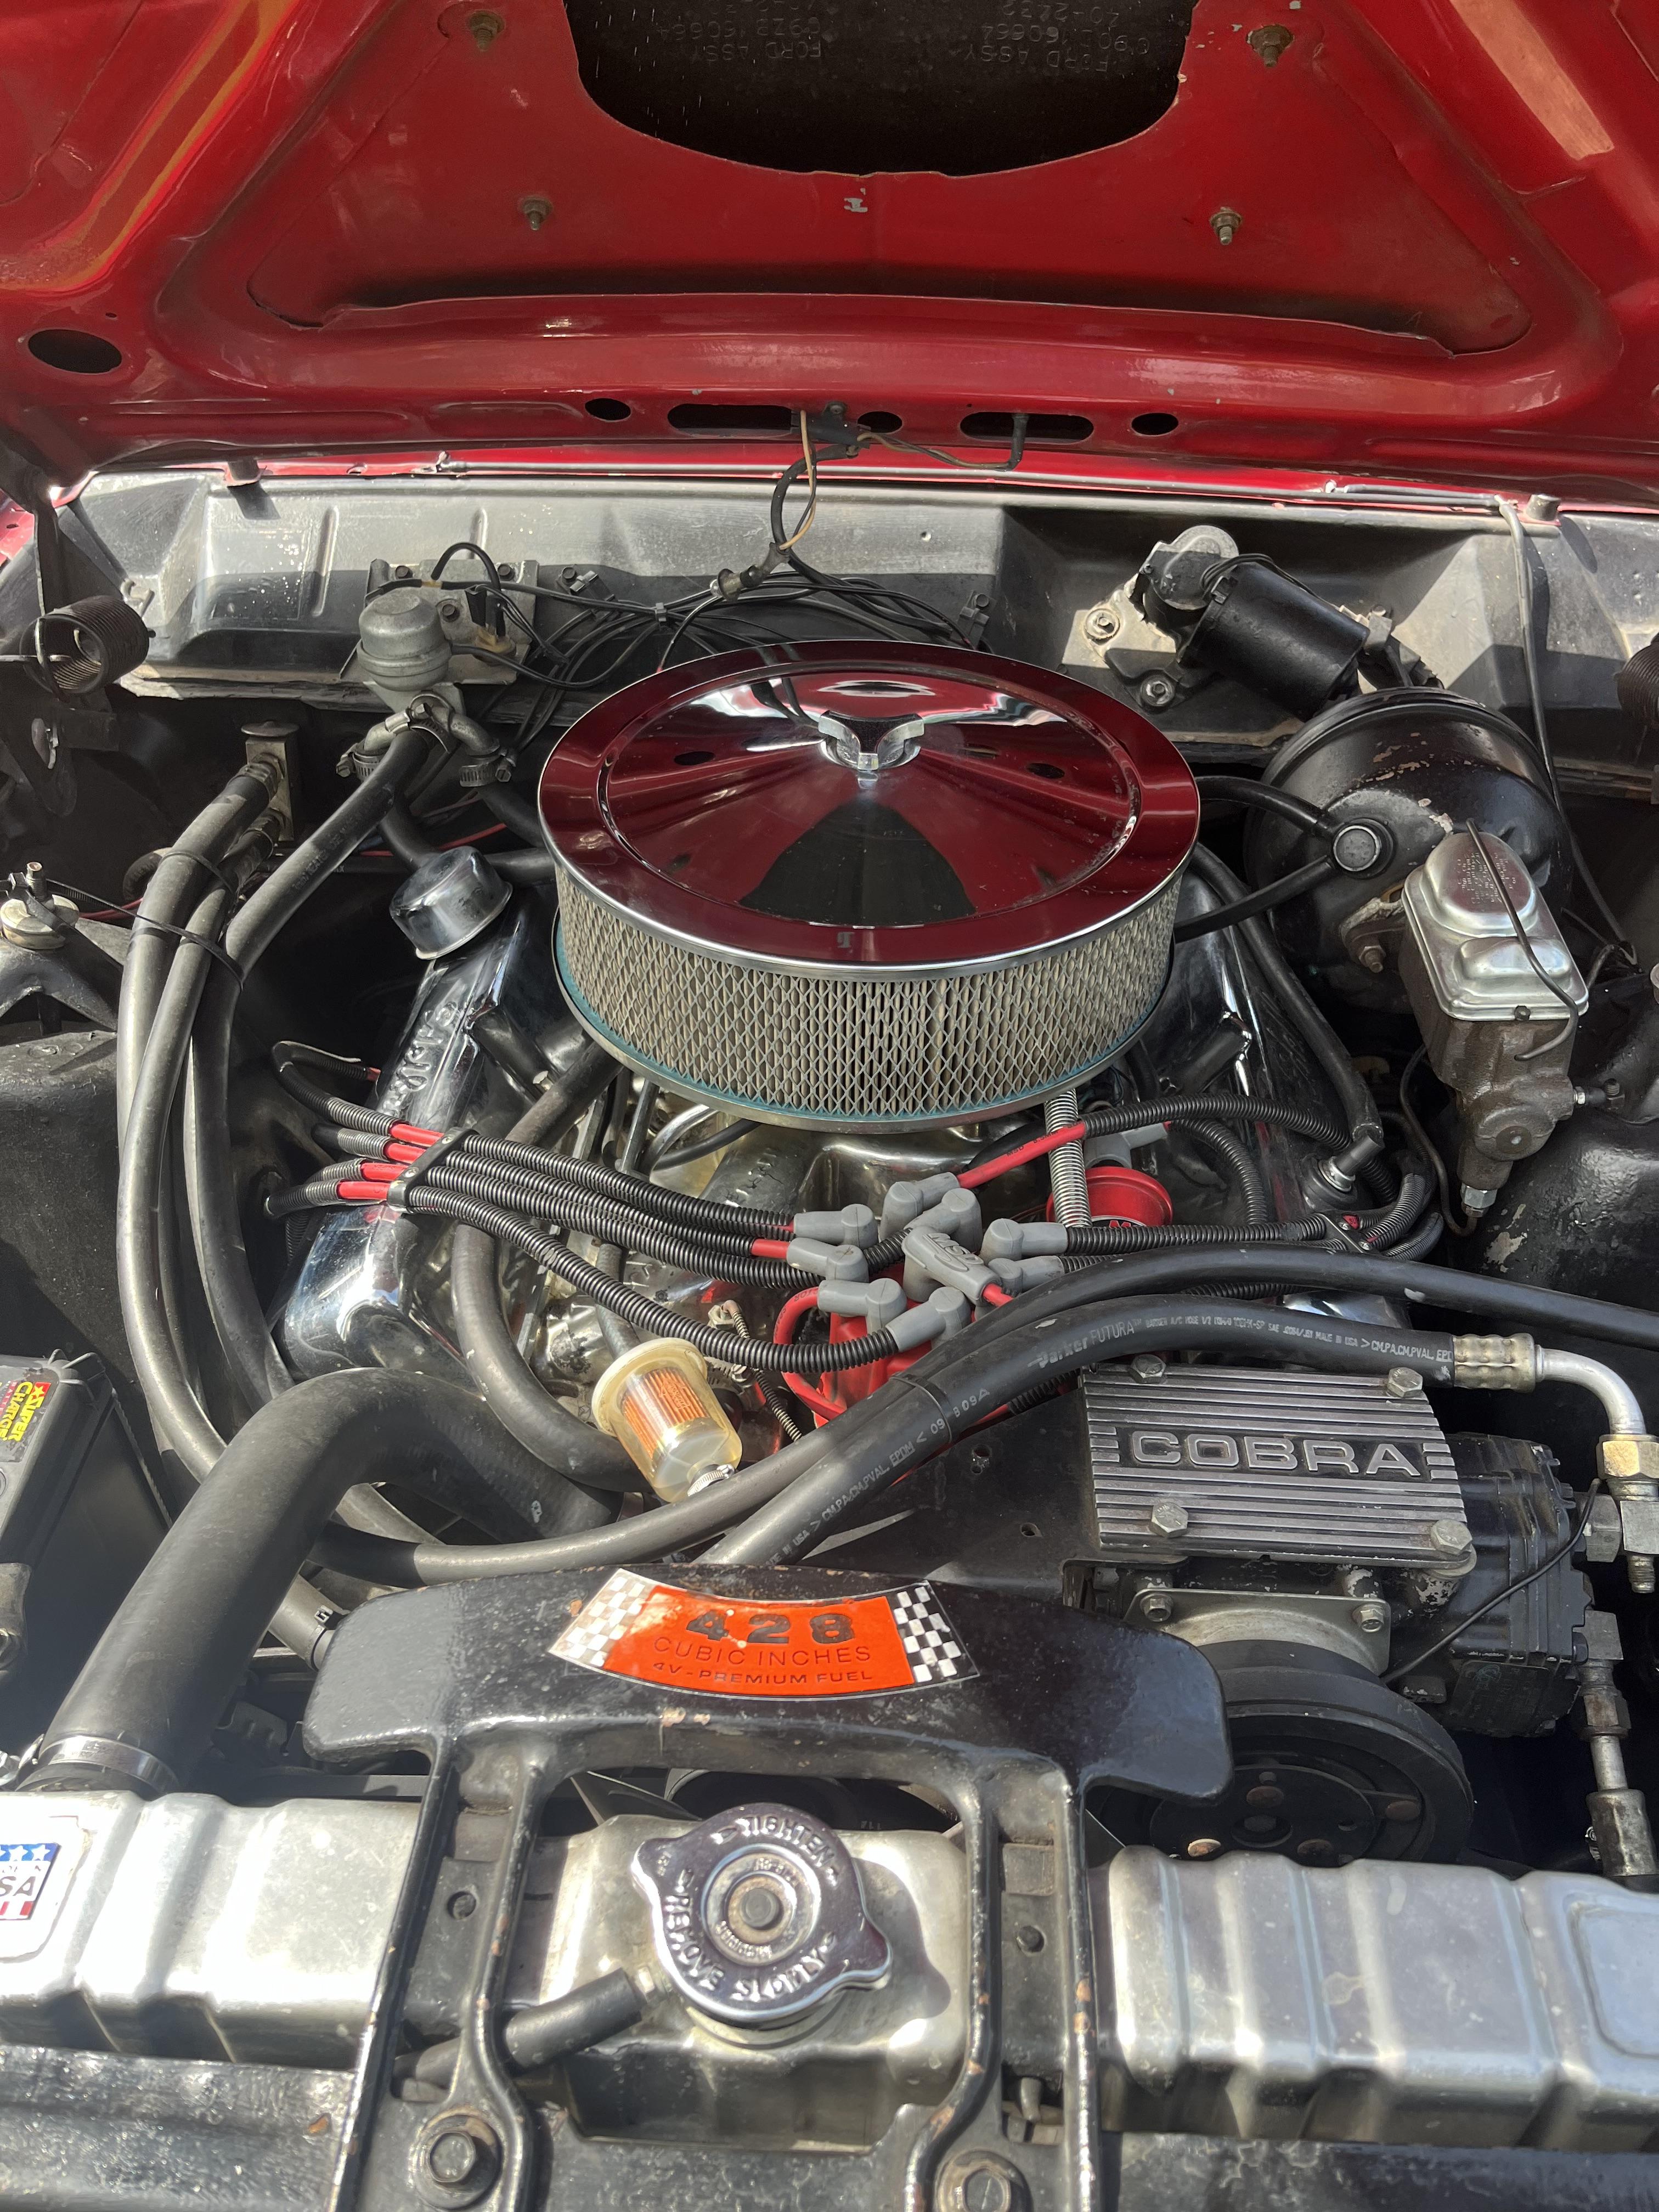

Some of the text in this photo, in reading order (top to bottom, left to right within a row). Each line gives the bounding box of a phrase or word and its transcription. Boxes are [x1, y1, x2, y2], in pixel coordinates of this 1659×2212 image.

[766, 41, 821, 59] FORD
[1046, 50, 1109, 71] FORD
[928, 1232, 984, 1265] MSD
[1037, 1337, 1088, 1368] Parker
[8, 1394, 44, 1442] SUPER
[1131, 1430, 1421, 1477] COBRA
[686, 1609, 856, 1644] 428
[654, 1637, 871, 1666] CUBIC INCHES
[817, 1671, 873, 1684] FUEL
[735, 1815, 837, 1871] TIGHTEN
[0, 1876, 36, 1897] SA
